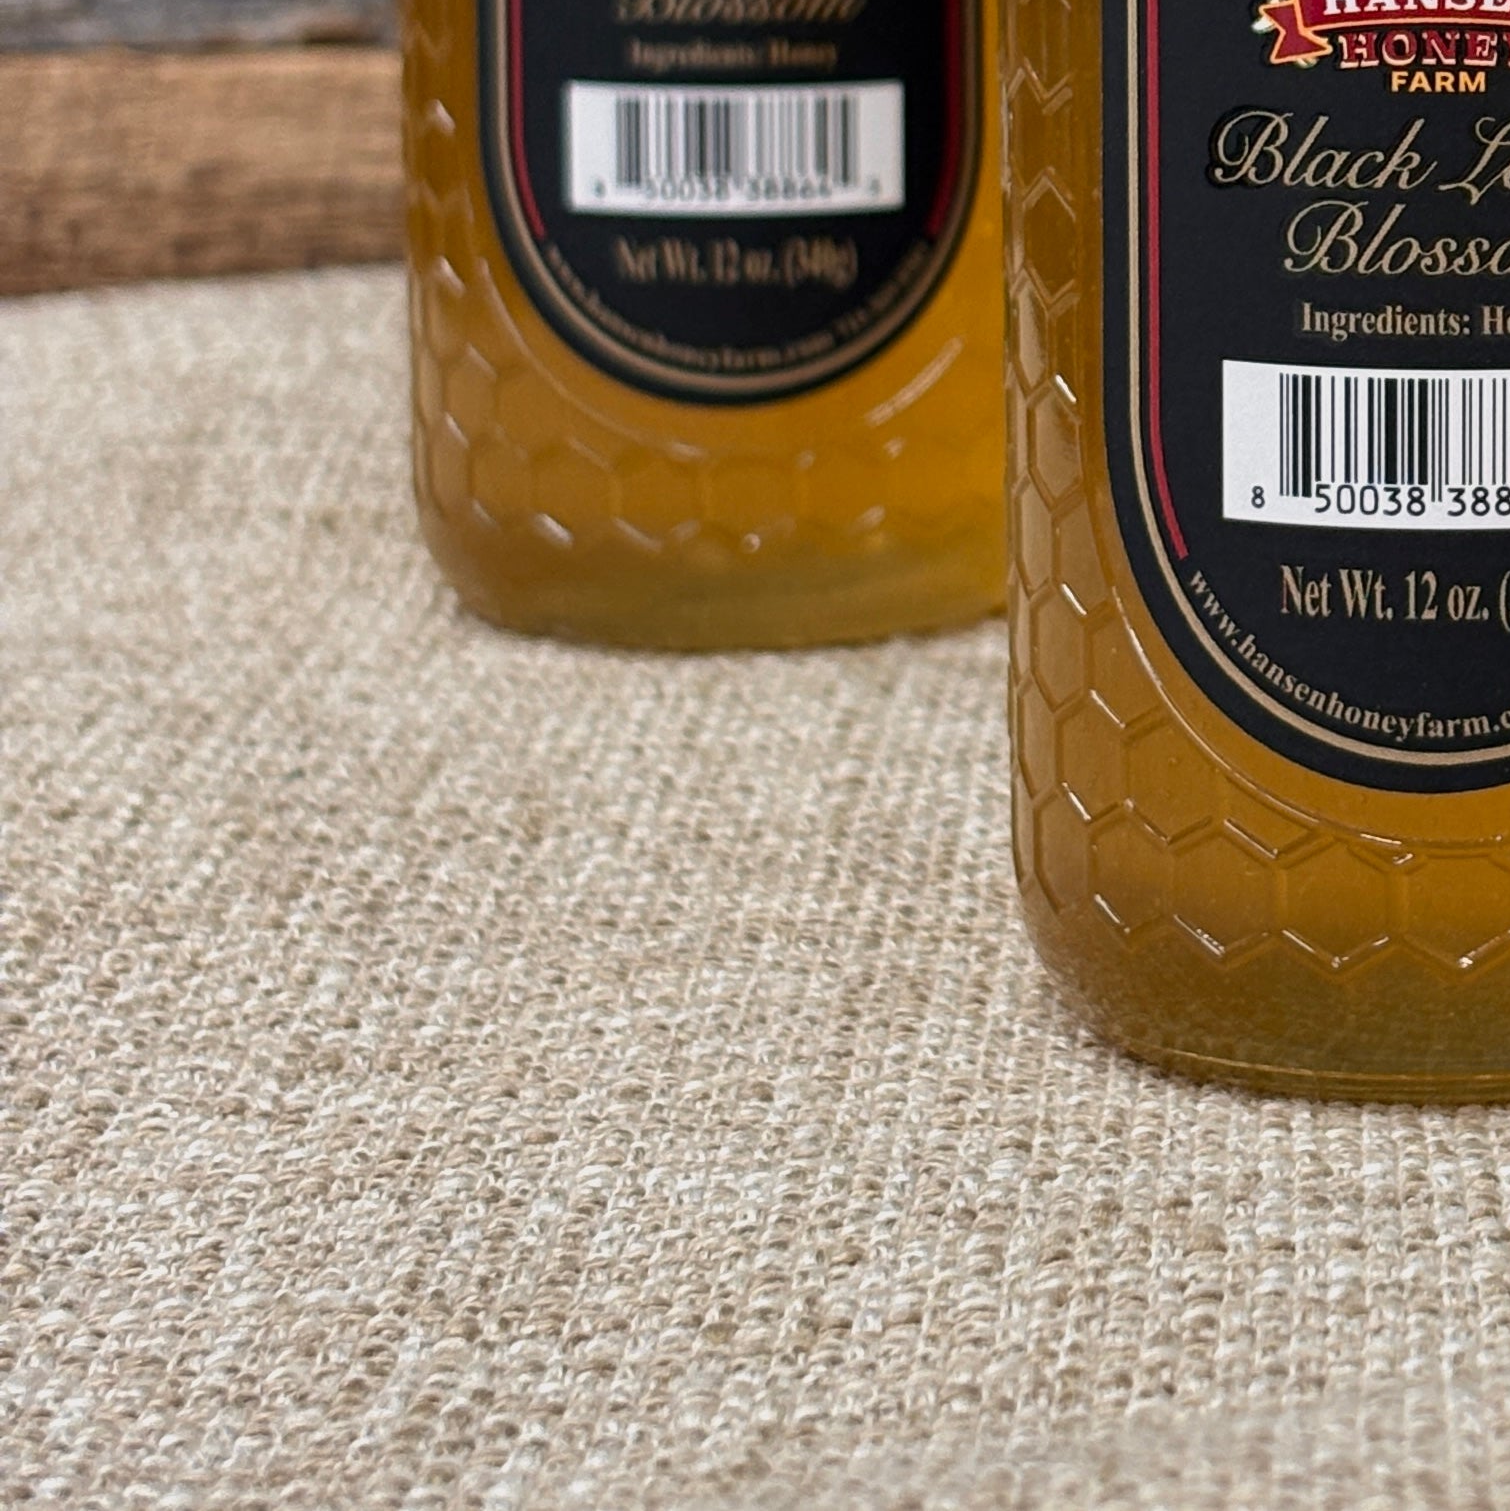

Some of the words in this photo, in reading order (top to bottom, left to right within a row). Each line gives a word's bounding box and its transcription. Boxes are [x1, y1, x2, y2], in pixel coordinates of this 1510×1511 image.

[1390, 71, 1487, 92] FARM
[1213, 111, 1435, 188] Black
[1301, 302, 1472, 337] Ingredients:
[1250, 487, 1265, 509] 8
[1313, 485, 1426, 515] 50038
[1280, 564, 1332, 619] Net
[1339, 569, 1394, 621] Wt.
[1405, 569, 1437, 621] 12
[1450, 584, 1489, 622] oz.
